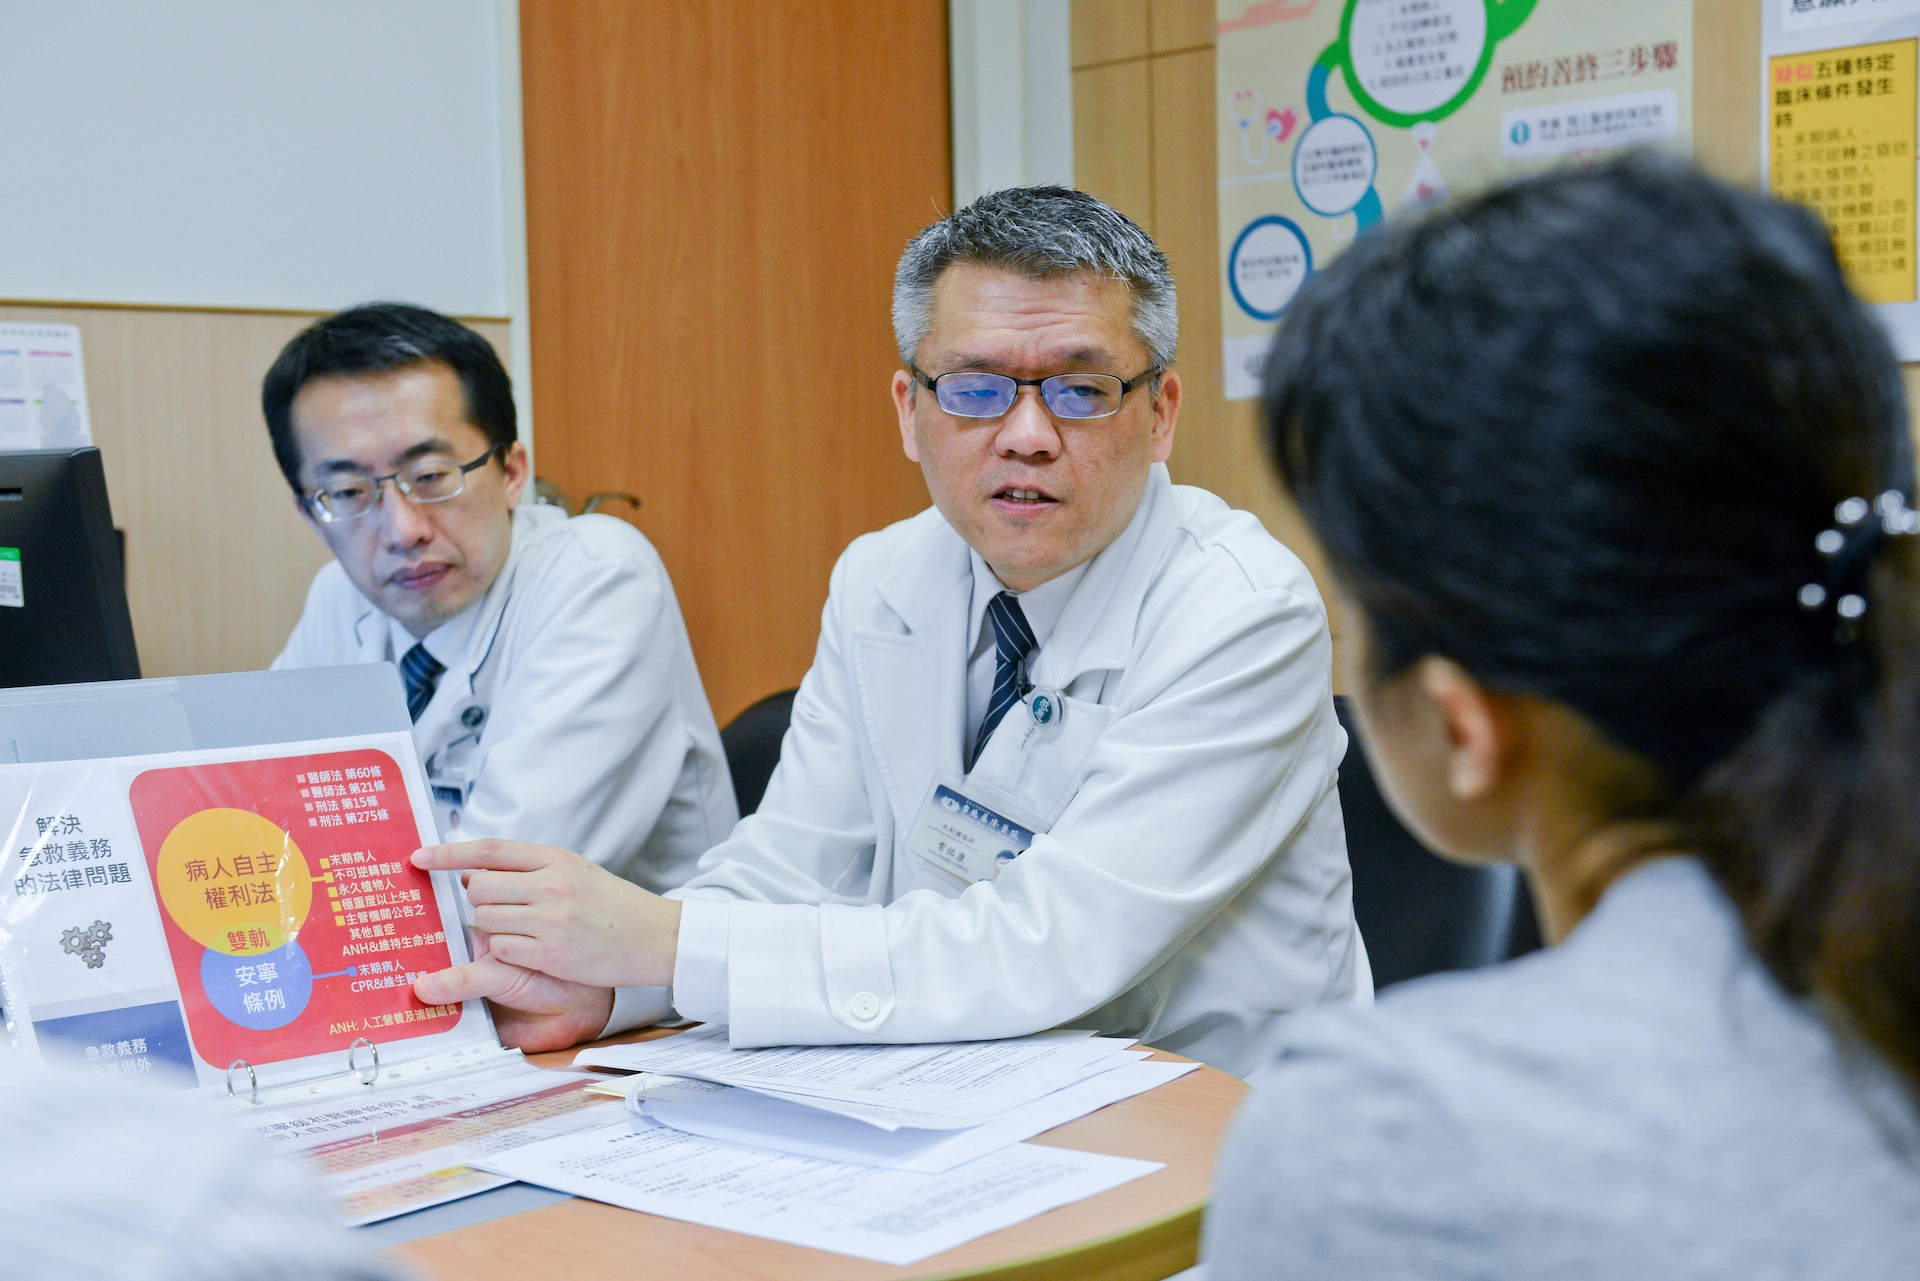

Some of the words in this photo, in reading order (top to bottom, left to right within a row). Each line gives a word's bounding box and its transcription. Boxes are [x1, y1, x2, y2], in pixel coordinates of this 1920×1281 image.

[1502, 40, 1678, 93] 預約善終三步驟
[1776, 77, 1895, 106] 臨床條件發生
[1776, 111, 1793, 129] 時
[306, 769, 344, 785] 醫師法
[345, 765, 382, 781] 第60條
[310, 783, 347, 799] 醫師法
[348, 780, 386, 795] 第21條
[315, 799, 340, 813] 刑法
[341, 795, 379, 810] 第15條
[35, 814, 83, 838] 解決
[319, 813, 344, 828] 刑法
[345, 808, 389, 825] 第275條
[19, 838, 112, 868] 急救義務
[329, 849, 377, 867] 末期病人
[184, 851, 278, 883] 病人自主
[333, 861, 403, 881] 不可逆轉昏迷
[14, 862, 132, 897] 的法律問題
[338, 877, 396, 896] 永久植物人
[204, 881, 277, 911] 權利法
[341, 888, 422, 911] 極重度以上失智
[345, 903, 426, 926] 主管機關公告之
[226, 927, 271, 952] 雙軌
[349, 922, 396, 941] 其他重症
[342, 930, 446, 957] ANH&維持生命治療
[235, 962, 278, 988] 安寧
[358, 958, 405, 977] 末期病人
[243, 988, 286, 1015] 條例
[329, 1020, 360, 1036] ANH:
[84, 1037, 148, 1061] 急救義務
